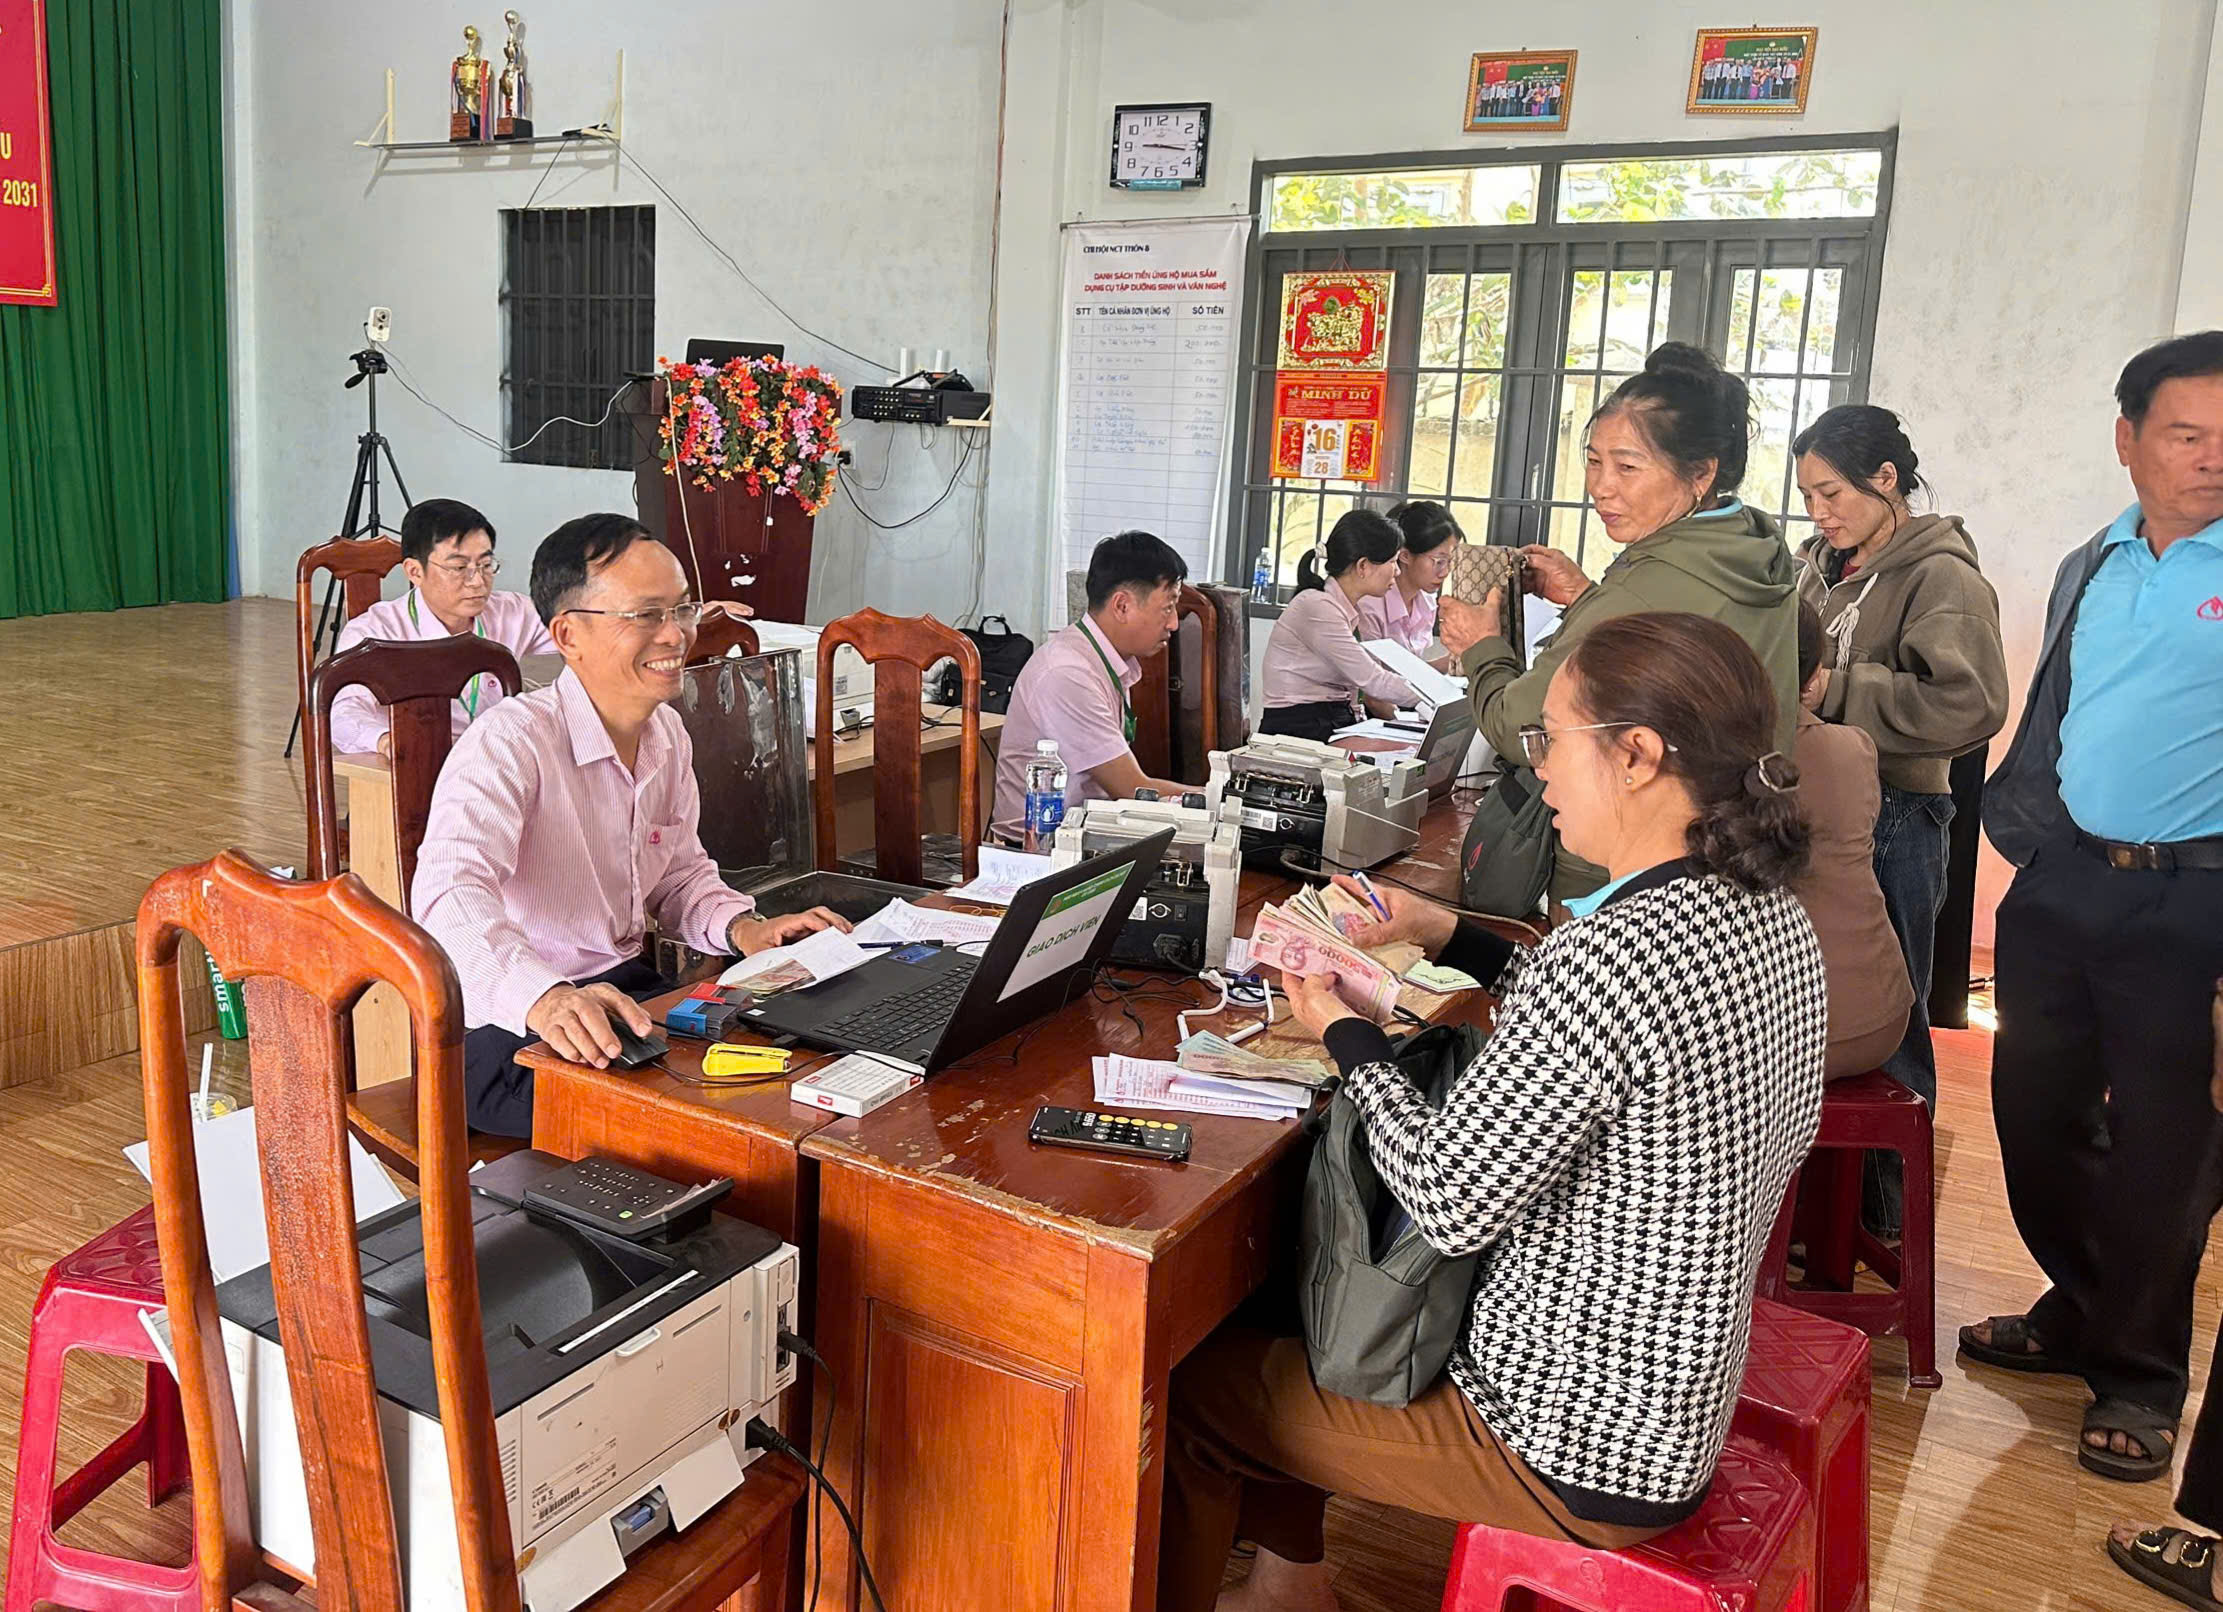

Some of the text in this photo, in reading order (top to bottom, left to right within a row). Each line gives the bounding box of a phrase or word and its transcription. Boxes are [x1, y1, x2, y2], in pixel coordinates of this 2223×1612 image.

[1144, 116, 1152, 127] 11
[1156, 115, 1169, 126] 12
[1175, 115, 1180, 126] 1
[1128, 124, 1140, 136] 10
[1184, 122, 1194, 134] 2
[1124, 141, 1133, 153] 9
[1189, 140, 1198, 151] 3
[1127, 157, 1137, 169] 8
[1182, 156, 1192, 167] 4
[1141, 166, 1149, 177] 7
[1154, 166, 1163, 178] 6
[1169, 165, 1178, 176] 5
[3, 178, 38, 208] 2031
[1094, 272, 1113, 280] DANH
[1114, 271, 1133, 280] SÁCH
[1181, 271, 1198, 279] MUA
[1157, 283, 1176, 291] SINH
[1075, 307, 1091, 315] STT
[1312, 427, 1337, 452] 16
[1313, 461, 1329, 475] 28
[1026, 936, 1054, 958] GIAO
